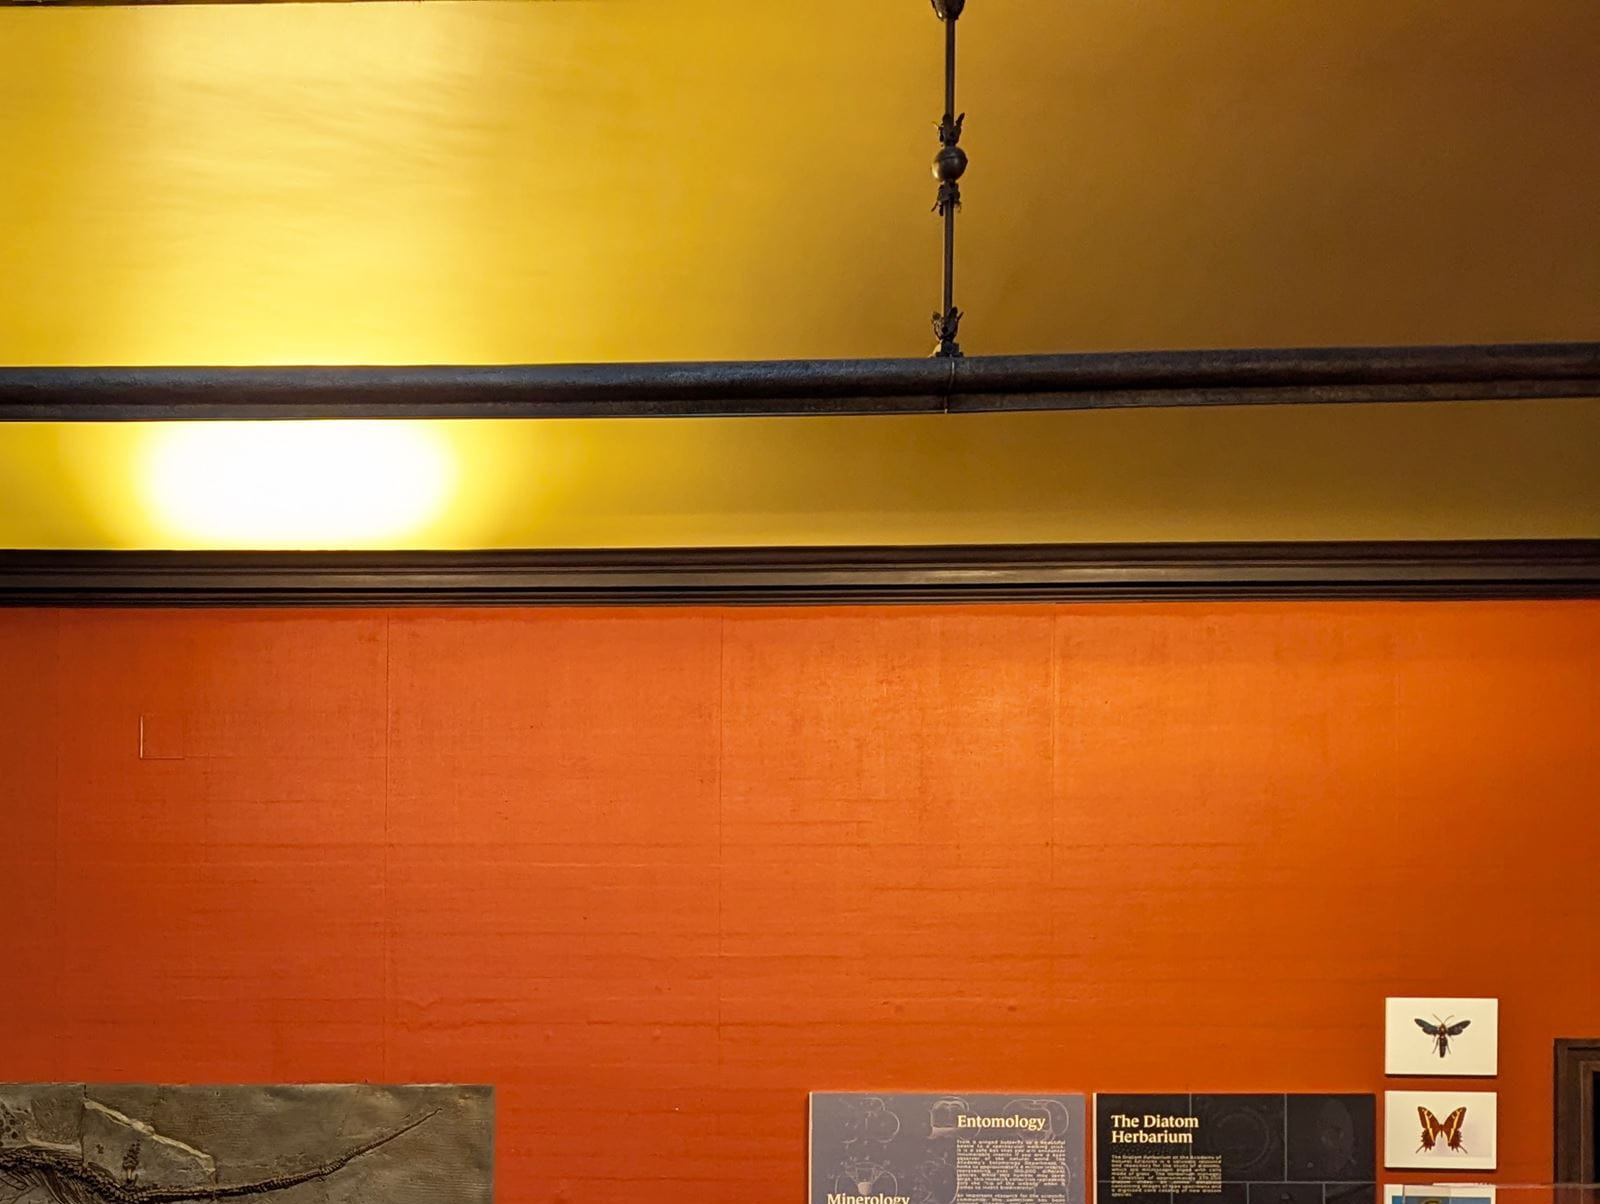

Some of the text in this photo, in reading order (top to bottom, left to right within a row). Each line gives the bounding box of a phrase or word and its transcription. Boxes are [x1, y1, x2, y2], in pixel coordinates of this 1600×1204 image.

[958, 1114, 1046, 1132] Entomology
[1110, 1114, 1198, 1129] The Diatom
[1112, 1130, 1192, 1144] Herbarium
